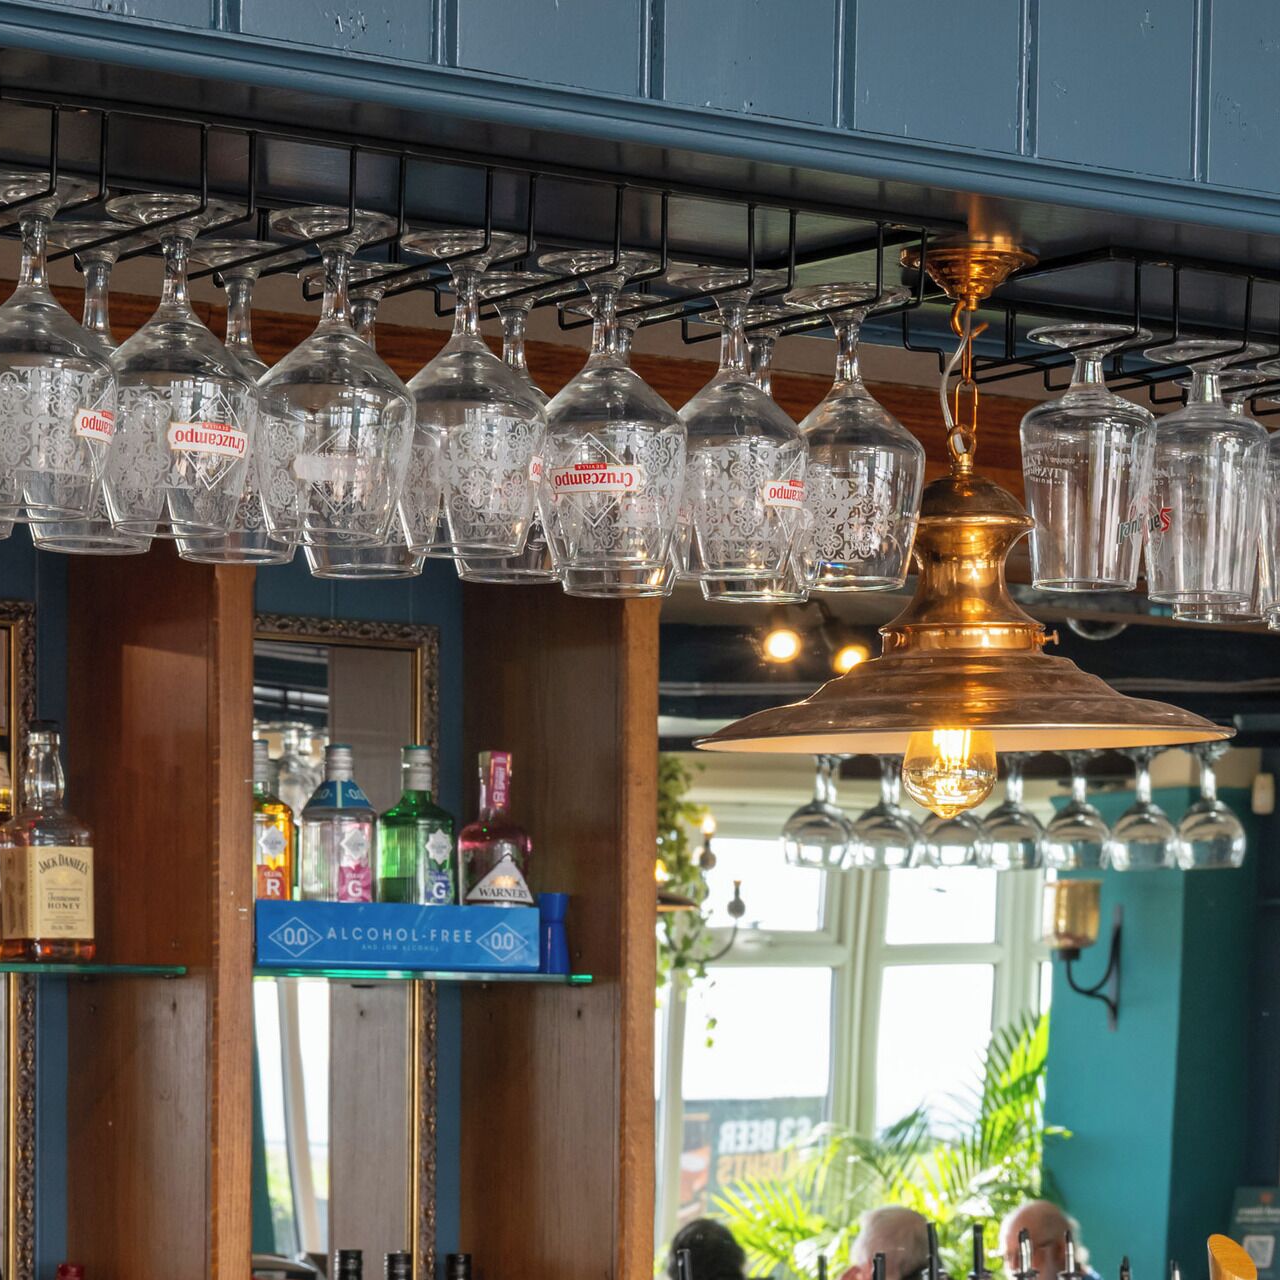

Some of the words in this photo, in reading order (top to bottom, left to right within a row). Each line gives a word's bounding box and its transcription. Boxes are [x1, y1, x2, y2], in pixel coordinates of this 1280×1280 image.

[175, 428, 245, 456] Cruzcampo
[554, 471, 634, 488] Cruzcampo
[266, 878, 280, 896] R
[347, 879, 363, 897] G
[432, 882, 446, 899] G
[47, 902, 81, 910] HONEY
[327, 927, 472, 944] ALCOHOL-FREE
